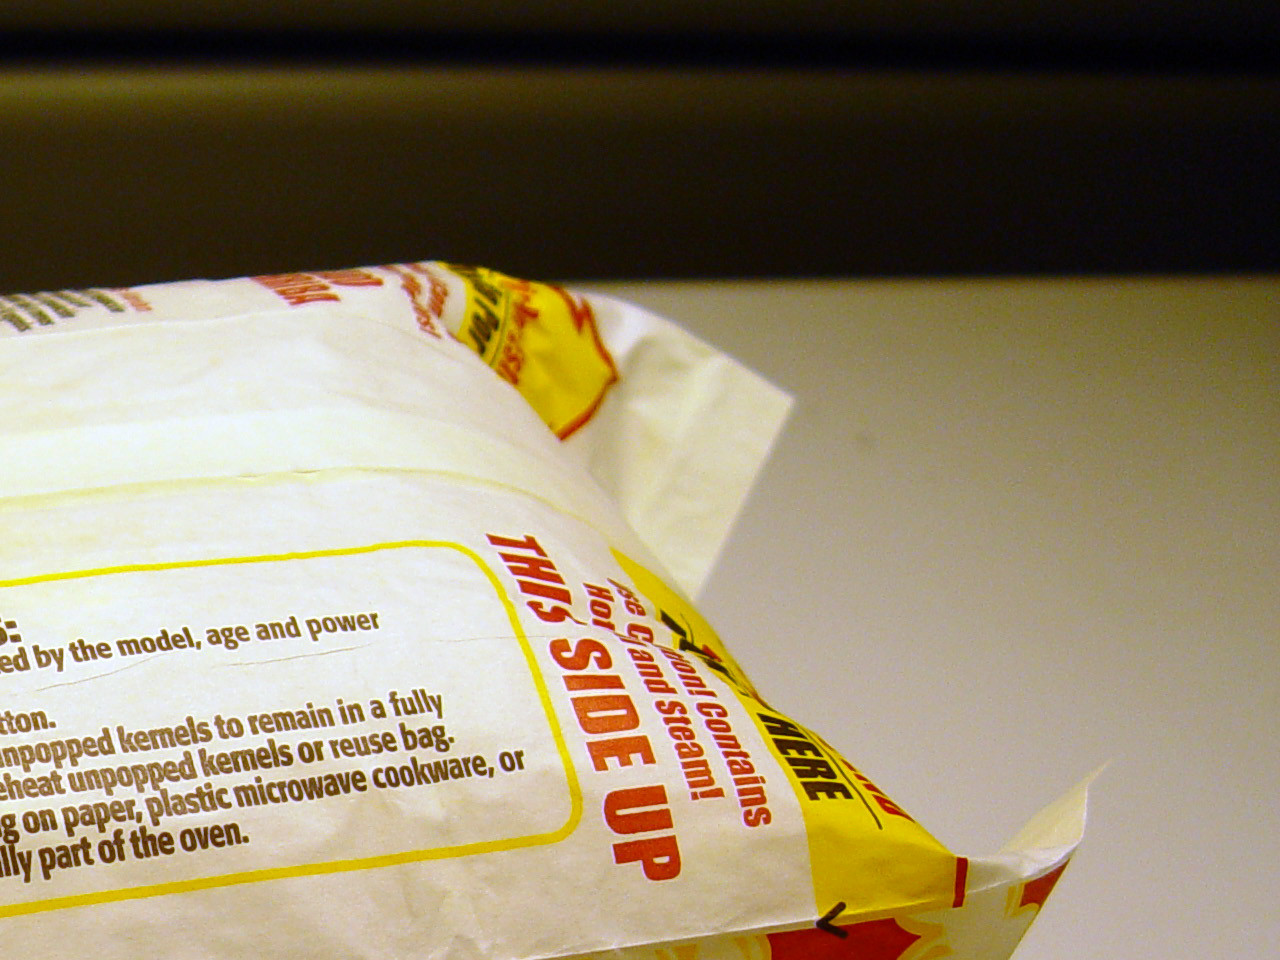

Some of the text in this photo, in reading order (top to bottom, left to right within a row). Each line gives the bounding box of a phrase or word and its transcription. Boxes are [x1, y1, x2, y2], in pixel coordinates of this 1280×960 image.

[32, 643, 64, 672] by
[68, 639, 113, 663] the
[117, 627, 202, 657] model,
[205, 623, 250, 650] age
[256, 616, 300, 642] and
[306, 611, 380, 642] power
[119, 717, 214, 753] kernels
[214, 715, 245, 739] to
[249, 703, 335, 735] remain
[339, 695, 365, 725] in
[370, 696, 387, 719] a
[389, 688, 444, 719] fully
[485, 533, 681, 882] THIS SIDE UP
[628, 646, 666, 695] and
[655, 701, 725, 801] Steam!
[23, 808, 57, 835] on
[62, 796, 143, 837] paper,
[147, 786, 229, 826] plastic
[233, 769, 367, 808] microwave
[372, 753, 495, 789] cookware,
[499, 748, 525, 772] or
[68, 753, 196, 795] unpopped
[199, 739, 294, 780] kernels
[297, 739, 324, 765] or
[329, 731, 398, 759] reuse
[400, 723, 455, 753] bag.
[695, 701, 772, 827] Contains
[756, 713, 854, 801] HERE
[40, 837, 93, 880] part
[97, 826, 127, 864] of
[129, 826, 175, 861] the
[179, 821, 250, 853] oven.
